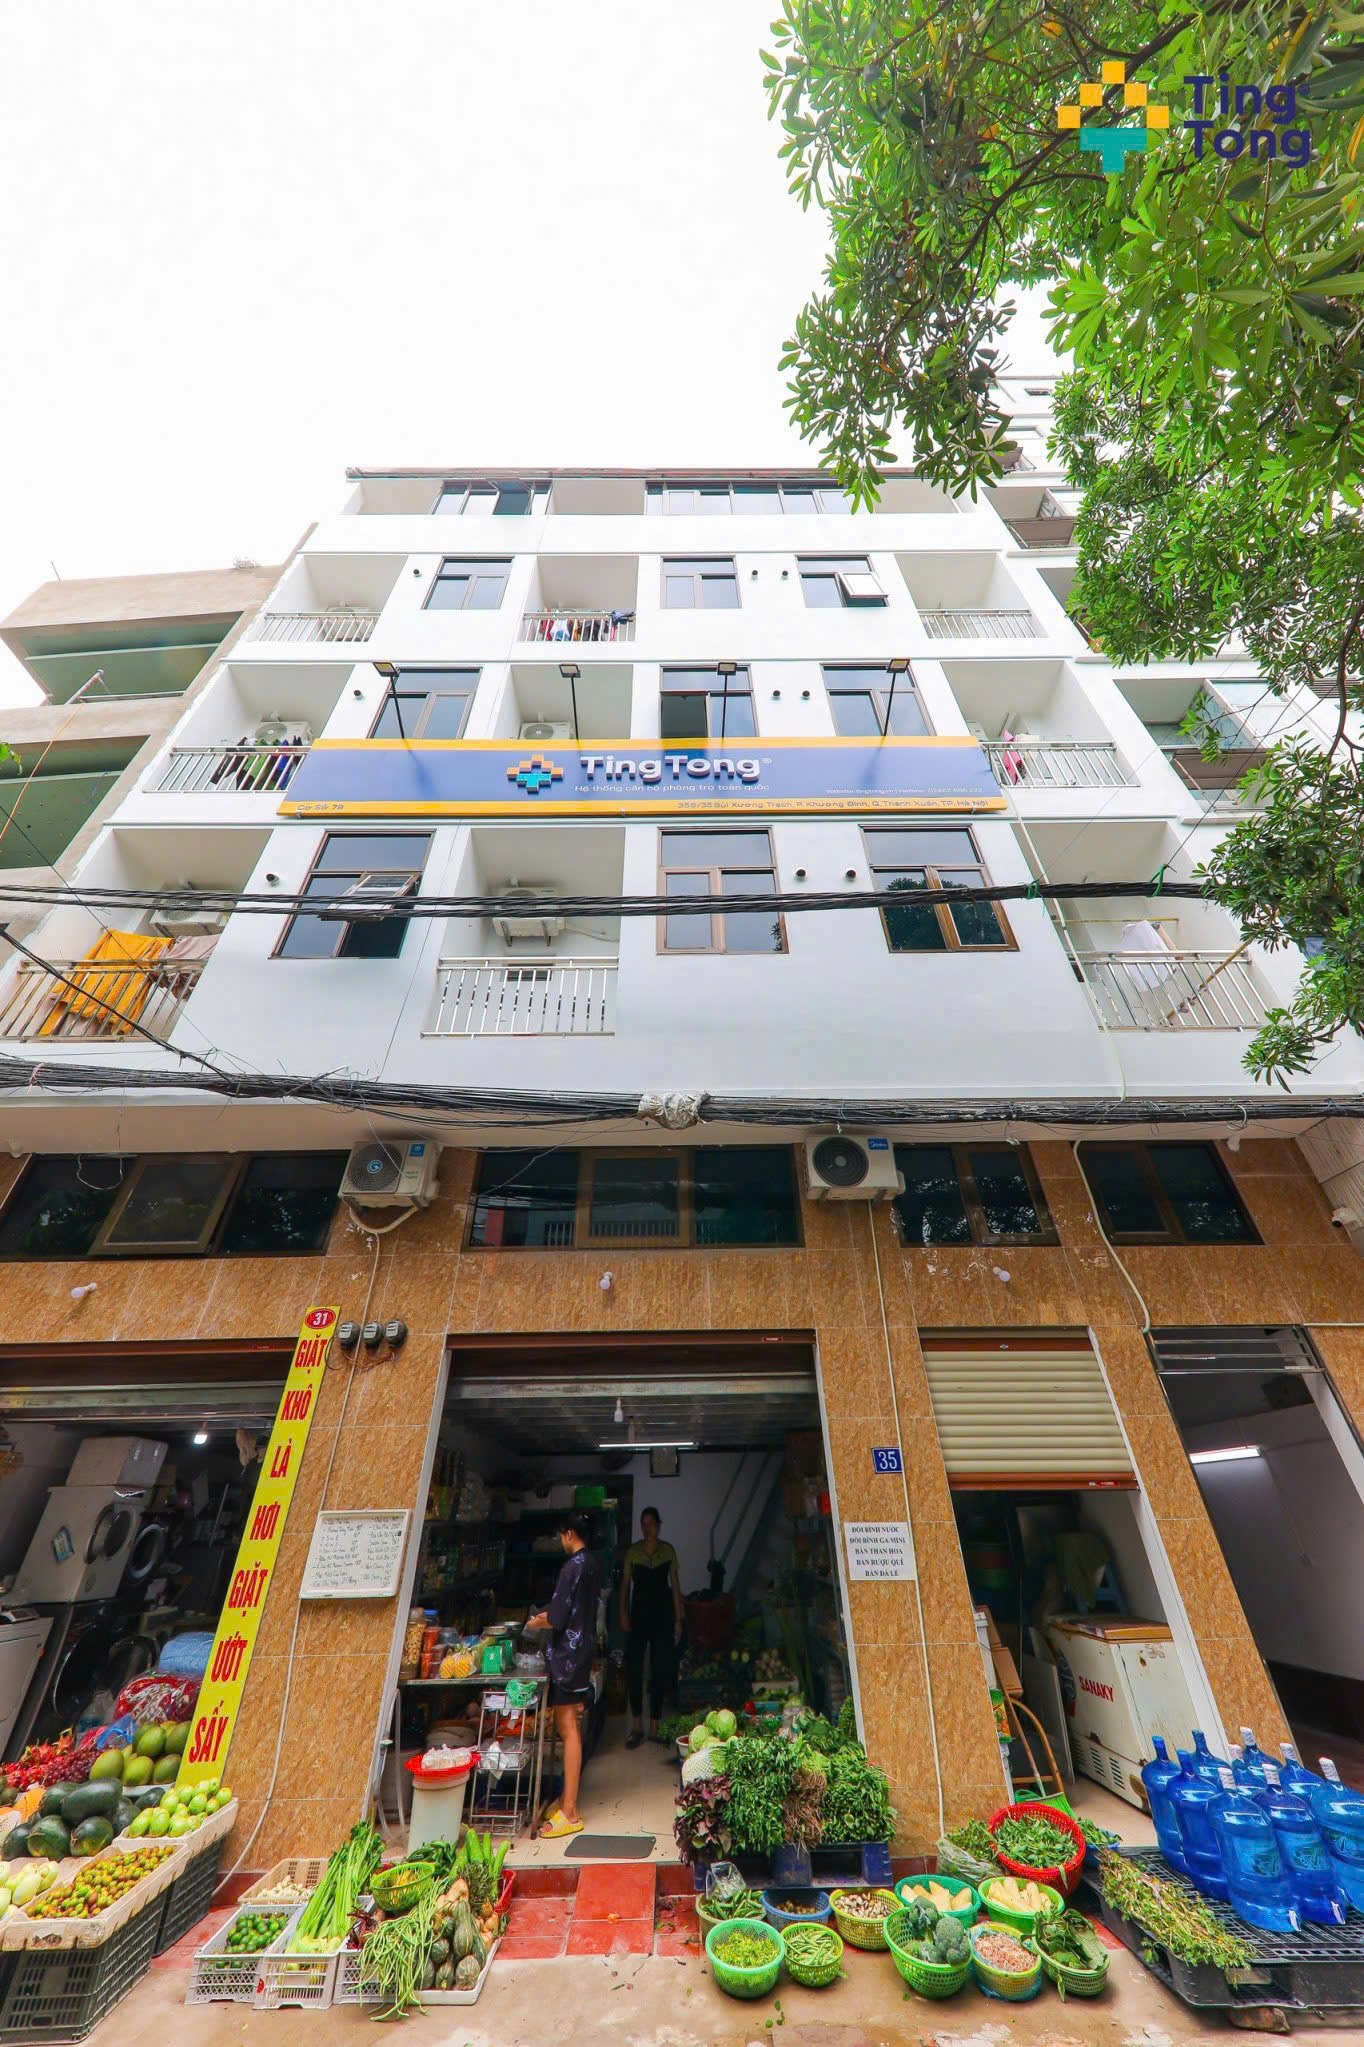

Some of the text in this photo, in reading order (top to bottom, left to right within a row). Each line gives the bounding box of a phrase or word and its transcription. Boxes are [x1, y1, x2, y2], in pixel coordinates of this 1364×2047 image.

[312, 1311, 329, 1327] 31
[294, 1337, 327, 1374] GIẶT
[280, 1384, 312, 1421] KHÔ
[269, 1438, 293, 1479] LÀ
[878, 1450, 898, 1470] 35
[249, 1504, 278, 1541] HƠI
[227, 1562, 268, 1618] GIẶT
[210, 1631, 247, 1683] ƯỚT
[1078, 1675, 1114, 1703] SANAKY
[188, 1701, 229, 1764] SẤY
